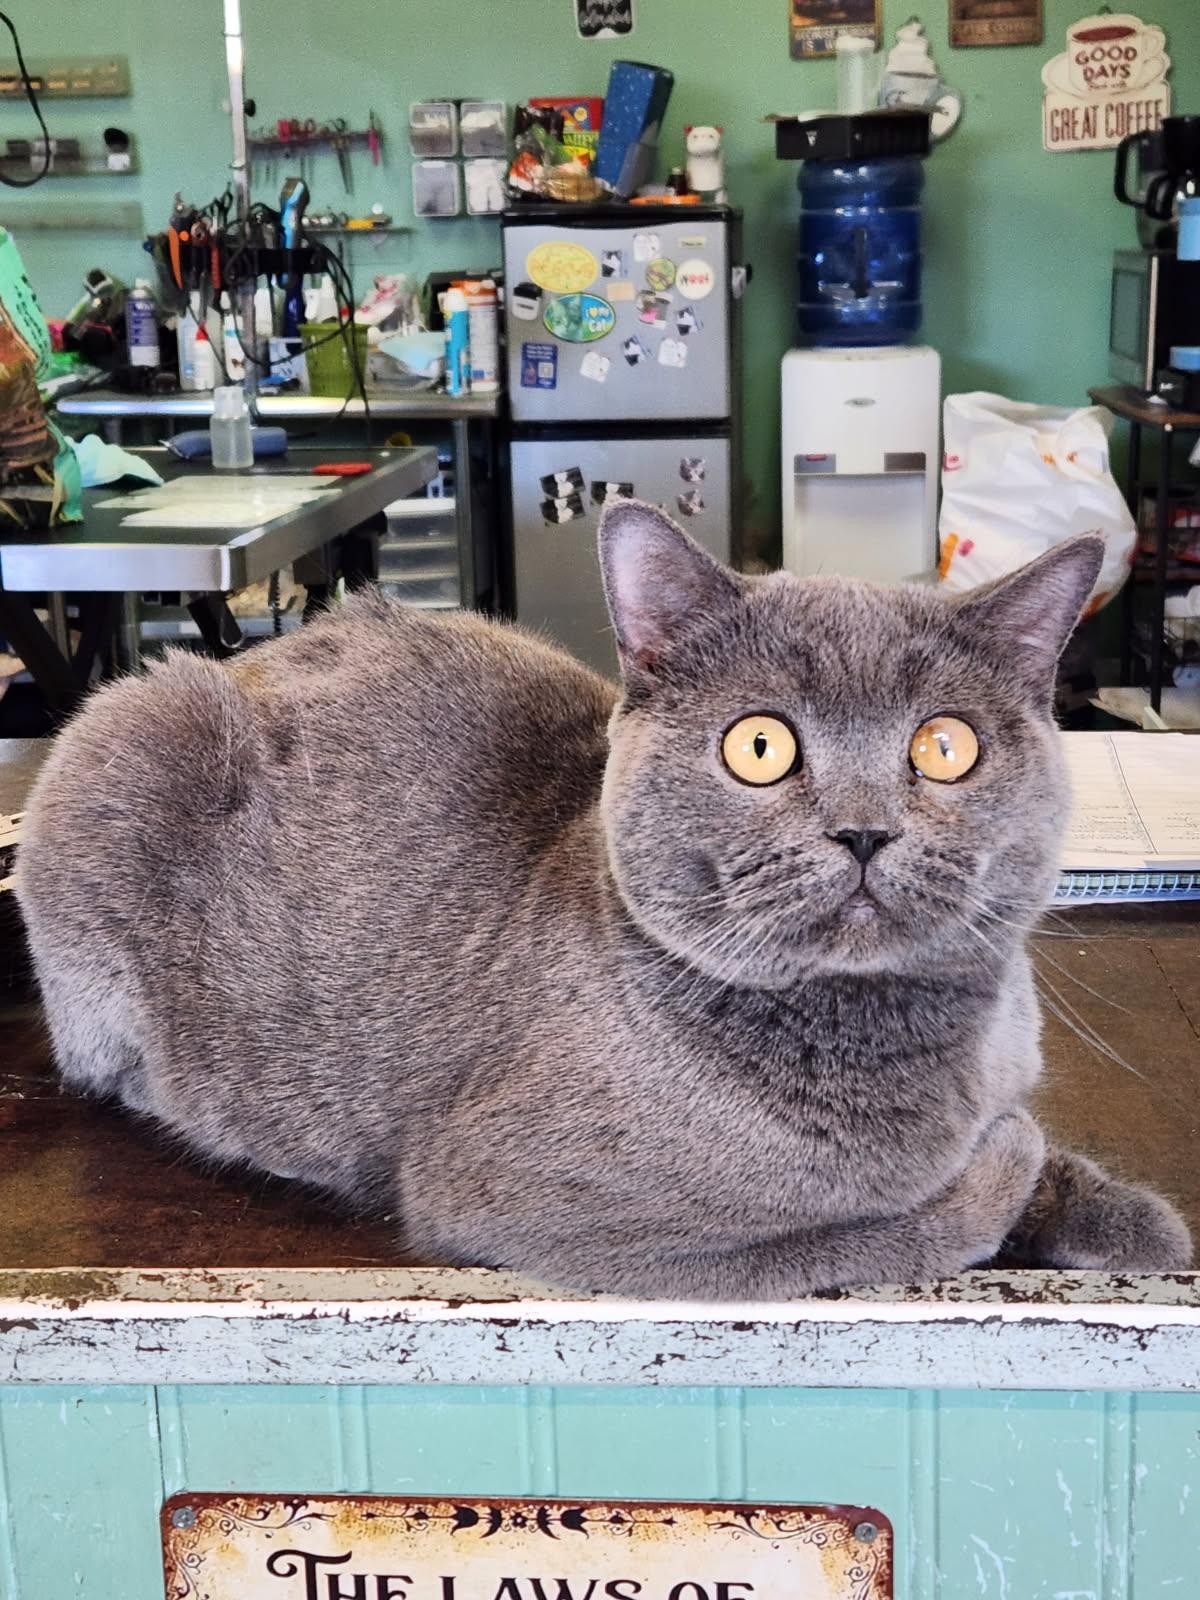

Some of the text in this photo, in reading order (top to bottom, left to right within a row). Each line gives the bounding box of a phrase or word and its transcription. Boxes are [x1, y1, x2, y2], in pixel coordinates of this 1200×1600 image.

[1075, 46, 1138, 65] GOOD
[1083, 64, 1131, 82] DAYS
[1051, 105, 1100, 142] GREAT
[266, 1549, 414, 1600] THE
